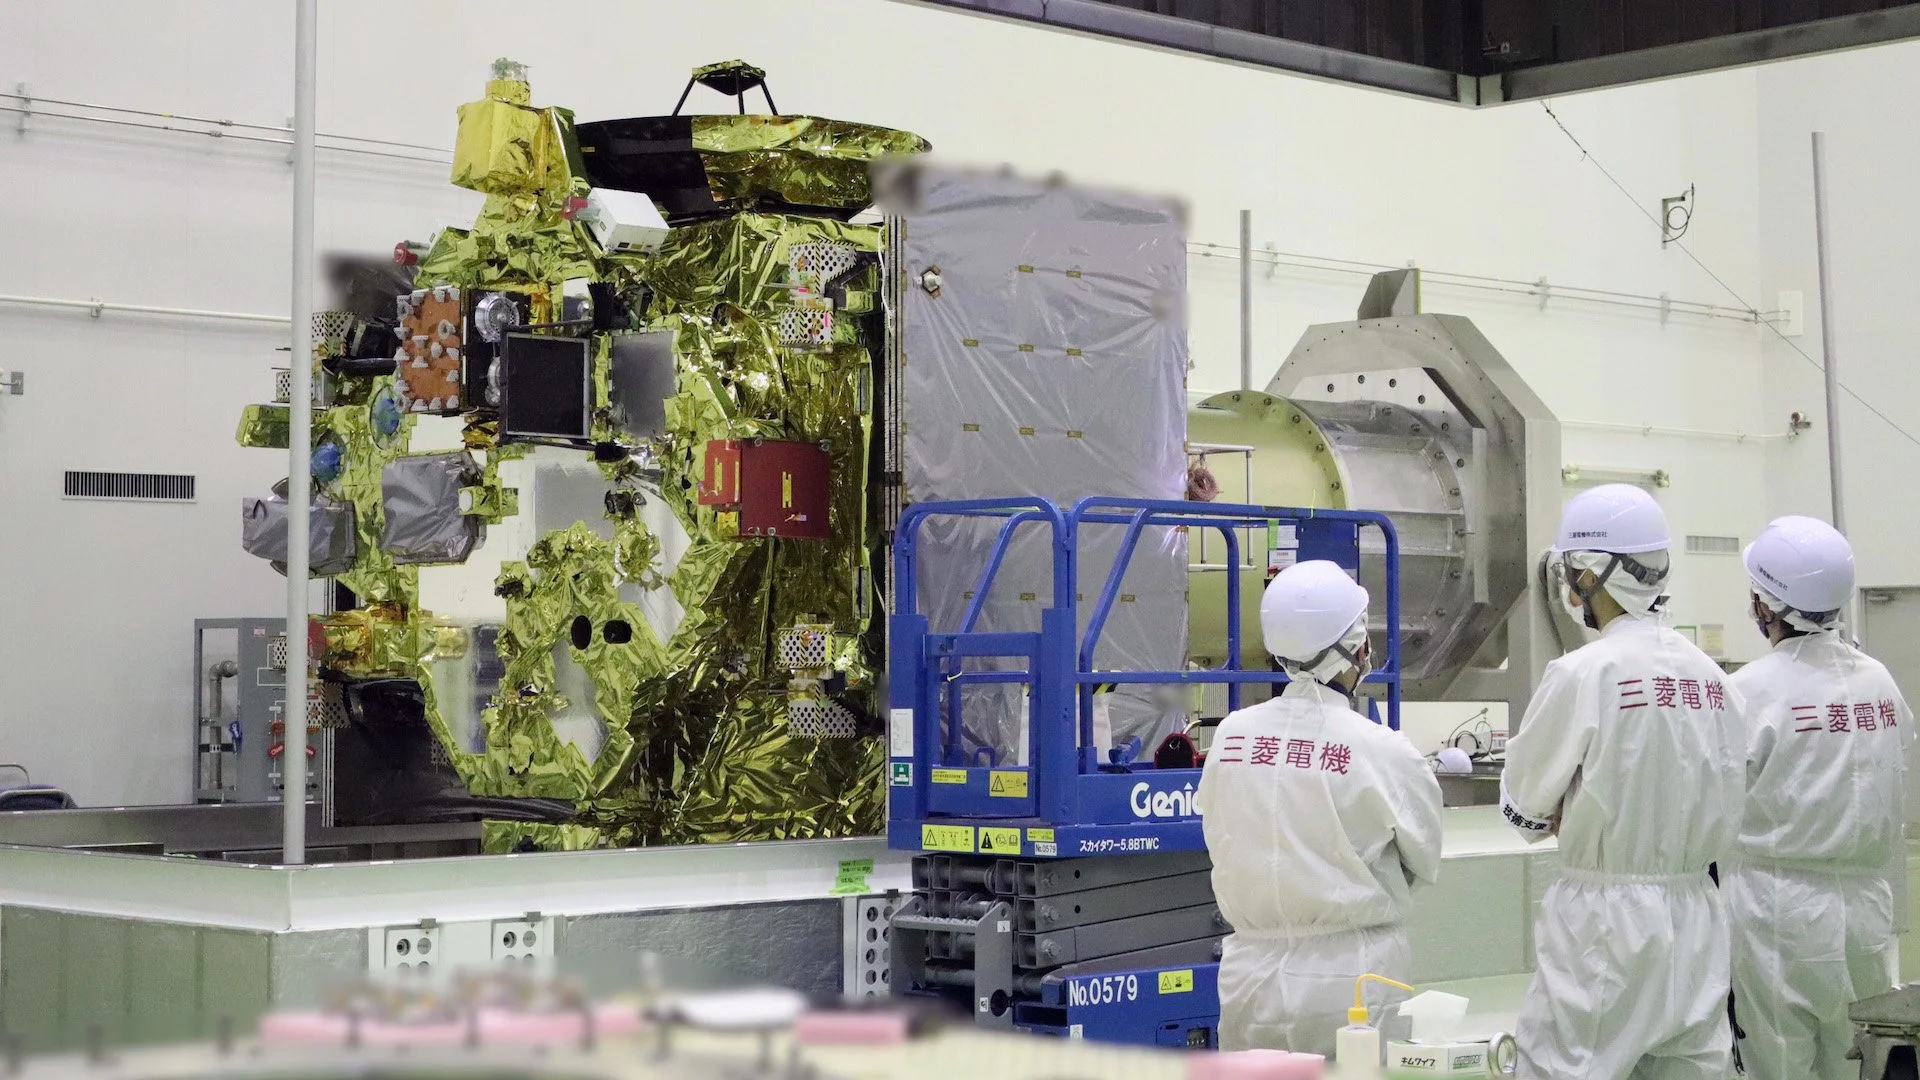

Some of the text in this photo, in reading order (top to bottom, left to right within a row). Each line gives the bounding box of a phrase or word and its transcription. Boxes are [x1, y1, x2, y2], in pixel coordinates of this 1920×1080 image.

[1617, 676, 1725, 711] 三菱電機
[1791, 699, 1897, 733] 三菱電機
[1219, 735, 1351, 776] 三菱電機
[1079, 837, 1160, 853] スカイタワー5.8BTWC
[1069, 974, 1138, 1007] No.0579
